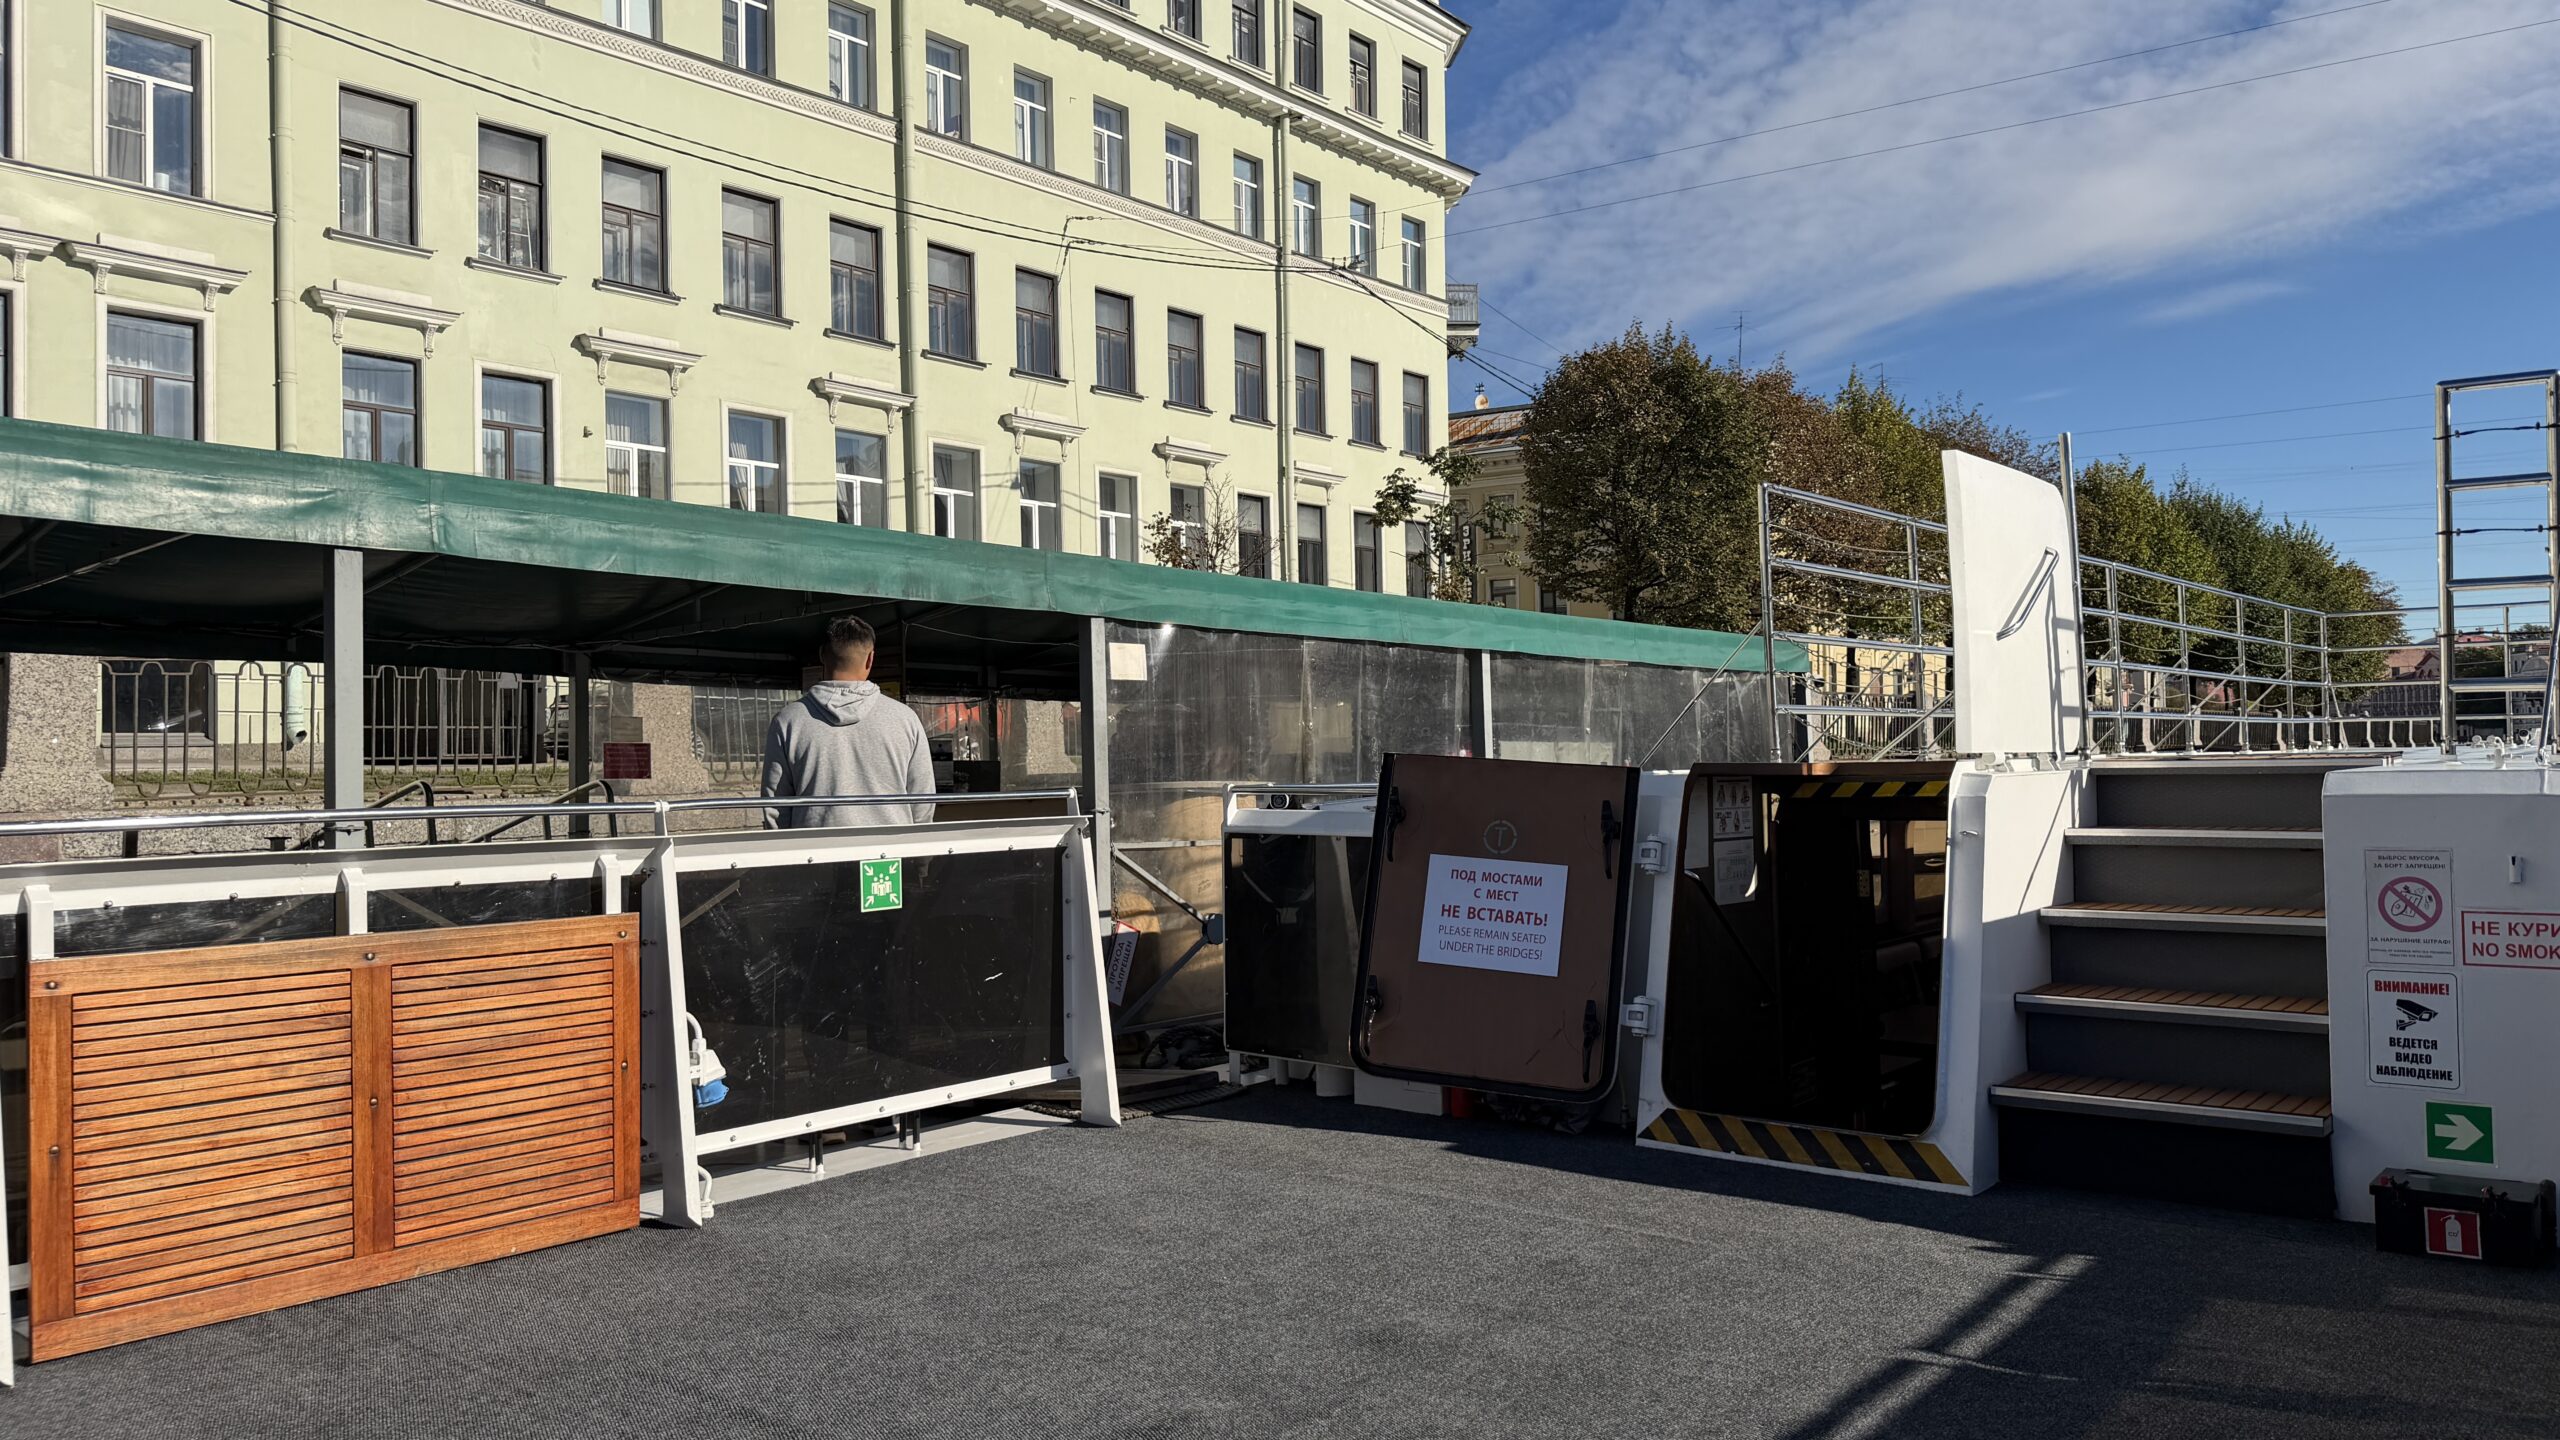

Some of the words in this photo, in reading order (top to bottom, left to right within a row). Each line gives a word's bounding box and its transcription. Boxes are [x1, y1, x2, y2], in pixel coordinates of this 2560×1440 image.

[1450, 868, 1477, 884] ПОД
[1481, 871, 1543, 887] МОСТАМИ
[1473, 887, 1482, 899] С
[1486, 888, 1519, 902] МЕСТ
[1440, 904, 1461, 918] НЕ
[1467, 906, 1549, 927] ВСТАВАТЬ!
[1438, 924, 1472, 937] PLEASE
[1473, 928, 1509, 941] REMAIN
[1511, 931, 1547, 945] SEATED
[2471, 920, 2500, 936] НЕ
[1439, 940, 1474, 953] UNDER
[1476, 943, 1495, 955] THE
[1497, 946, 1543, 960] BRIDGES!
[2472, 942, 2500, 957] NO
[2505, 943, 2560, 960] SMOK
[2374, 980, 2450, 996] ВНИМАНИЕ!
[2389, 1036, 2438, 1050] ВЕДЕТСЯ
[2395, 1052, 2432, 1065] ВИДЕО
[2376, 1065, 2454, 1081] НАБЛЮДЕНИЕ
